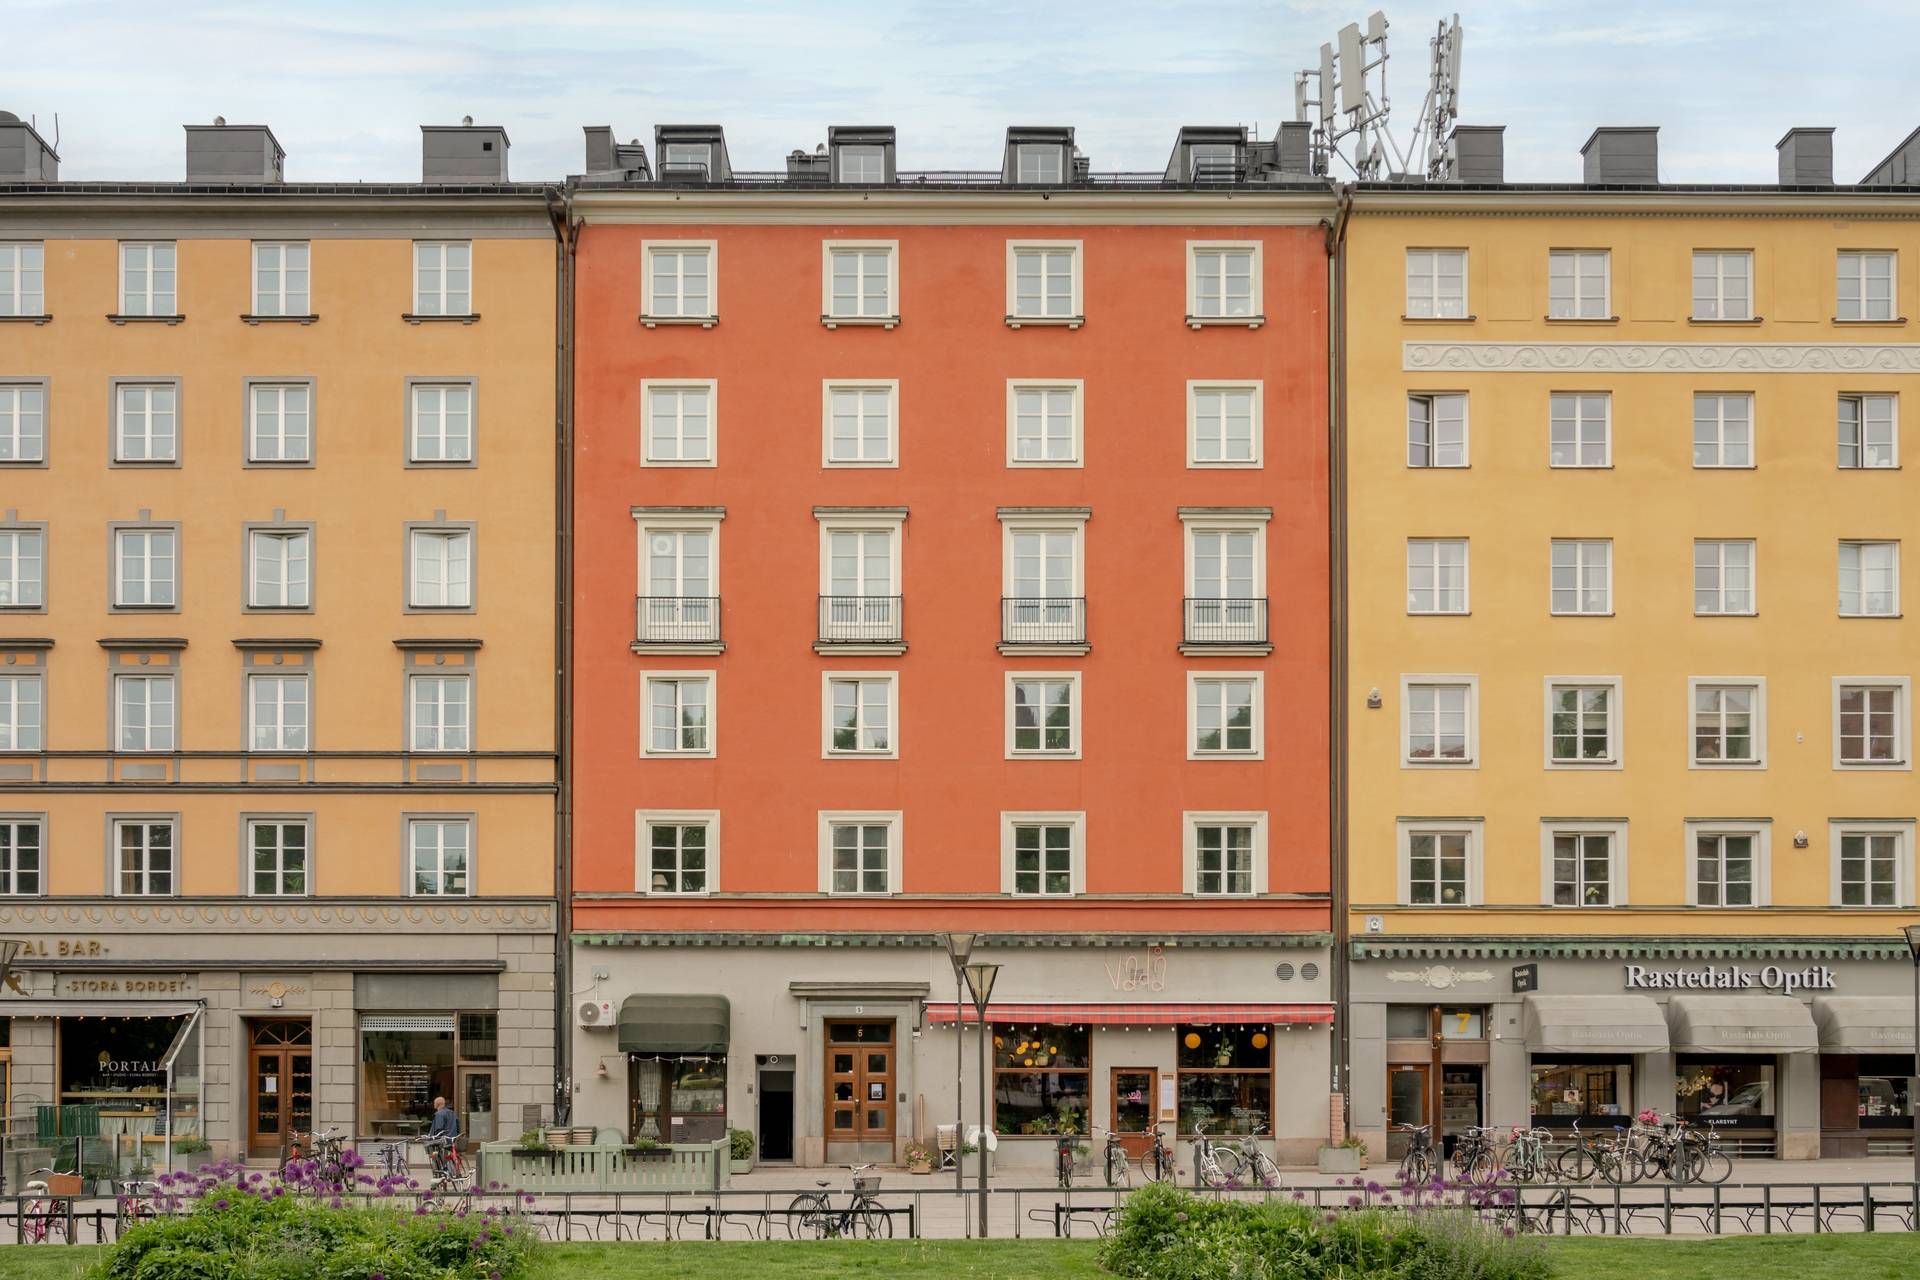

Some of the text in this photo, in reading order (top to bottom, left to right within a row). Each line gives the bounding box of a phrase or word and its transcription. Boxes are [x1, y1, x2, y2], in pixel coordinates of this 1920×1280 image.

[1626, 965, 1837, 994] Rastedals Optik
[1456, 1012, 1472, 1034] 7
[99, 1060, 160, 1072] PORTAL
